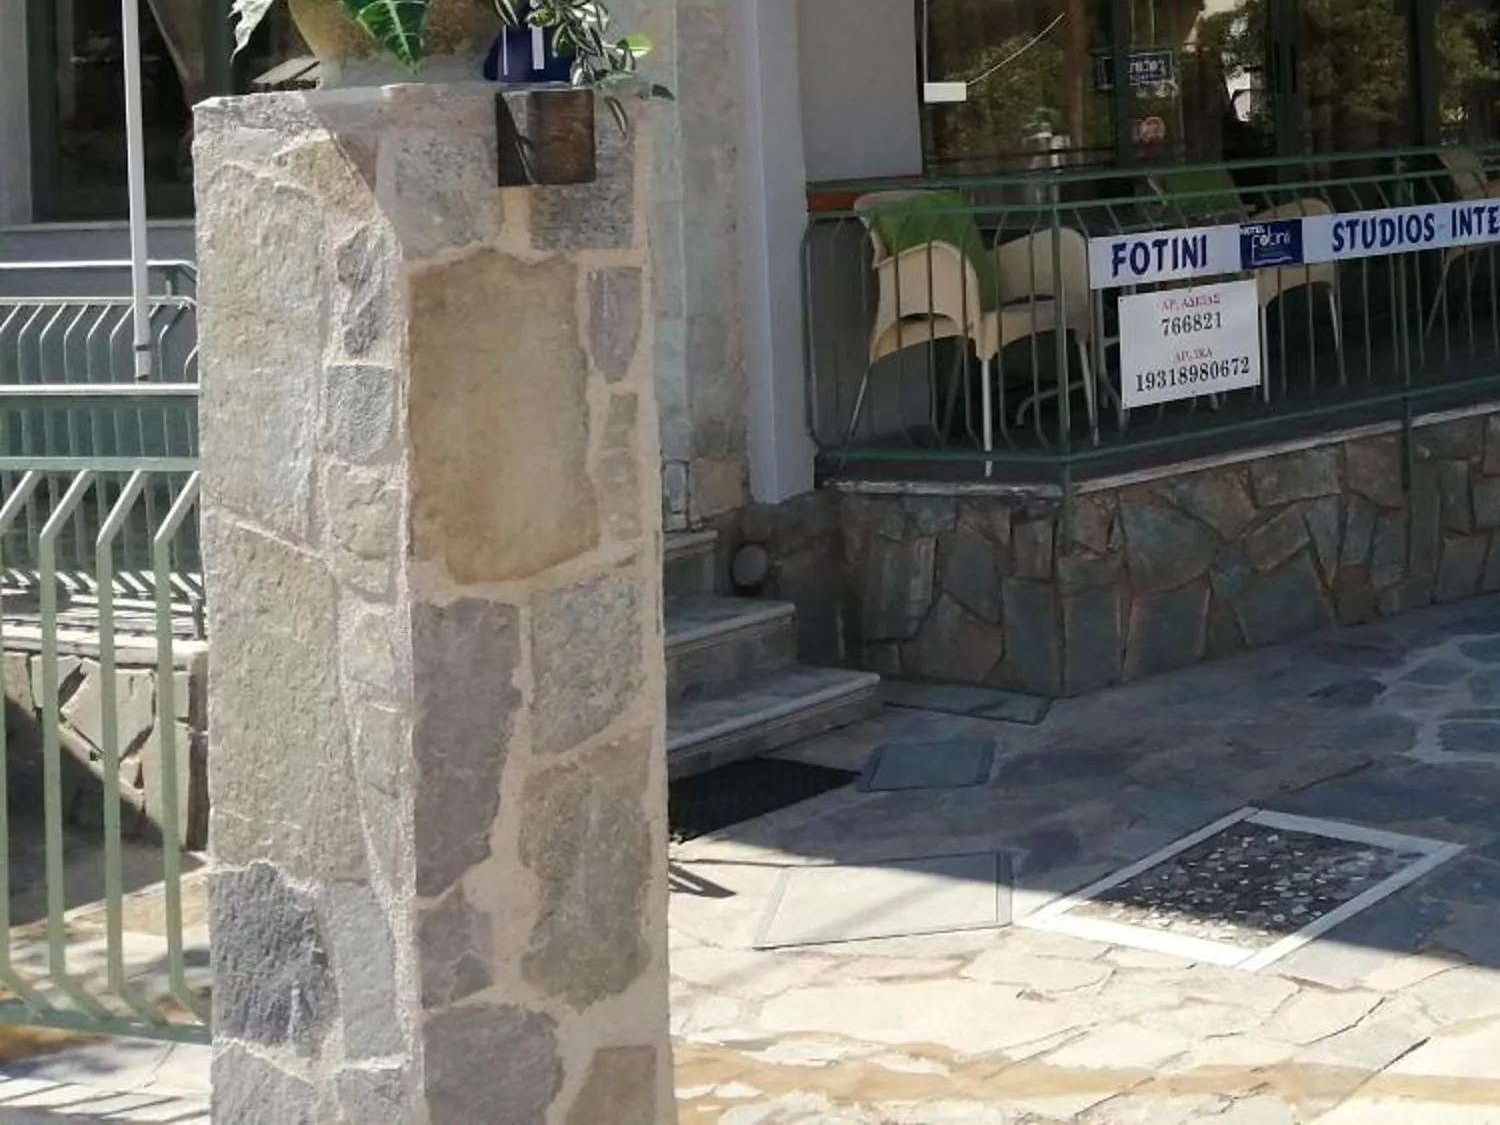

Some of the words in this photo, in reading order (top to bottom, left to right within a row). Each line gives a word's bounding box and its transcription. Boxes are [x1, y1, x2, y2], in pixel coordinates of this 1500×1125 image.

[1331, 211, 1436, 253] STUDIOS
[1110, 234, 1208, 277] FOTINI
[1161, 311, 1222, 337] 766821
[1135, 356, 1250, 393] 19318980672
